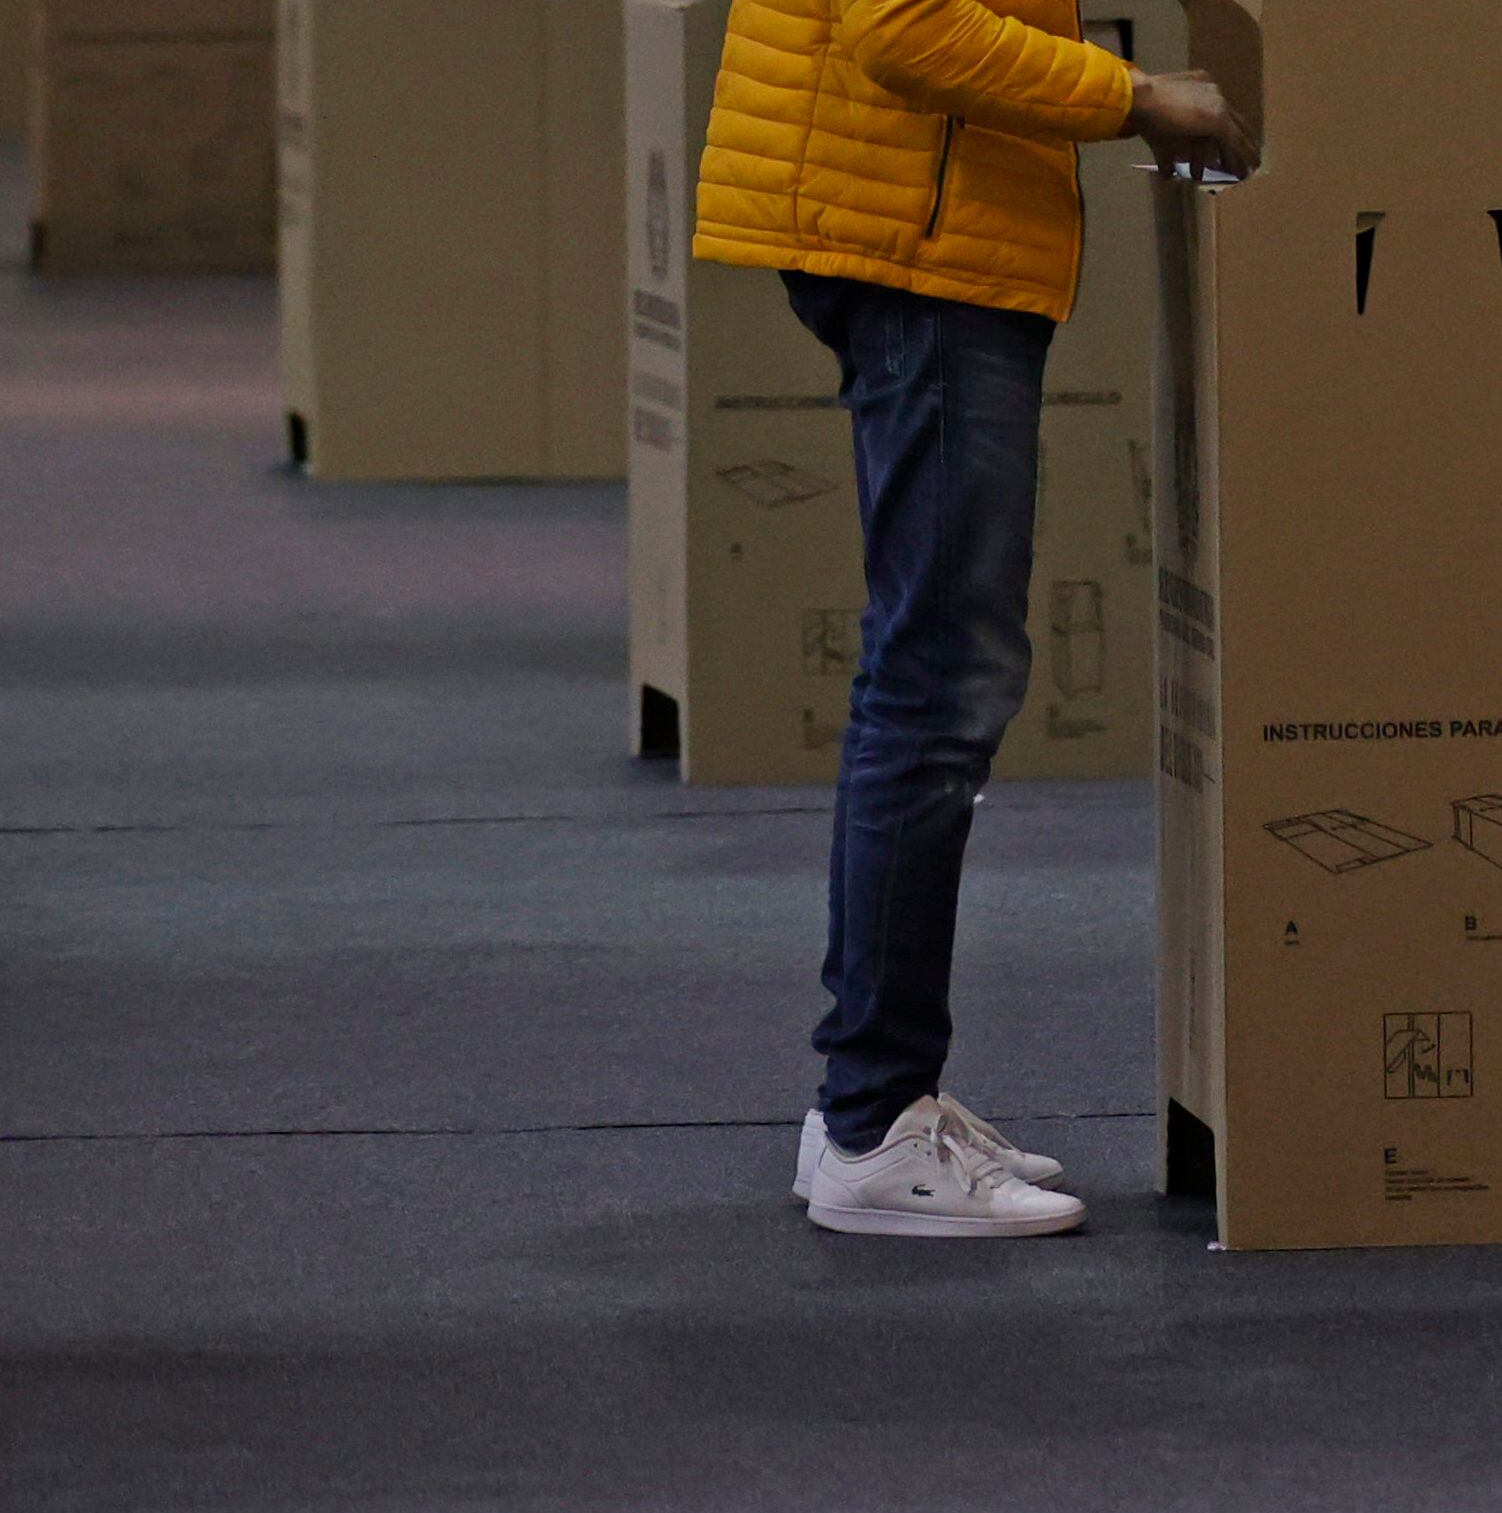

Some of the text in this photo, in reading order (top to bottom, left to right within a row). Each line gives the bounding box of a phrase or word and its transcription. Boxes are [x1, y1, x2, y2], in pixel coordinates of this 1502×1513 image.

[1263, 720, 1443, 742] INSTRUCCIONES
[1285, 920, 1298, 936] A
[1464, 915, 1478, 932] B
[1383, 1147, 1397, 1165] E
